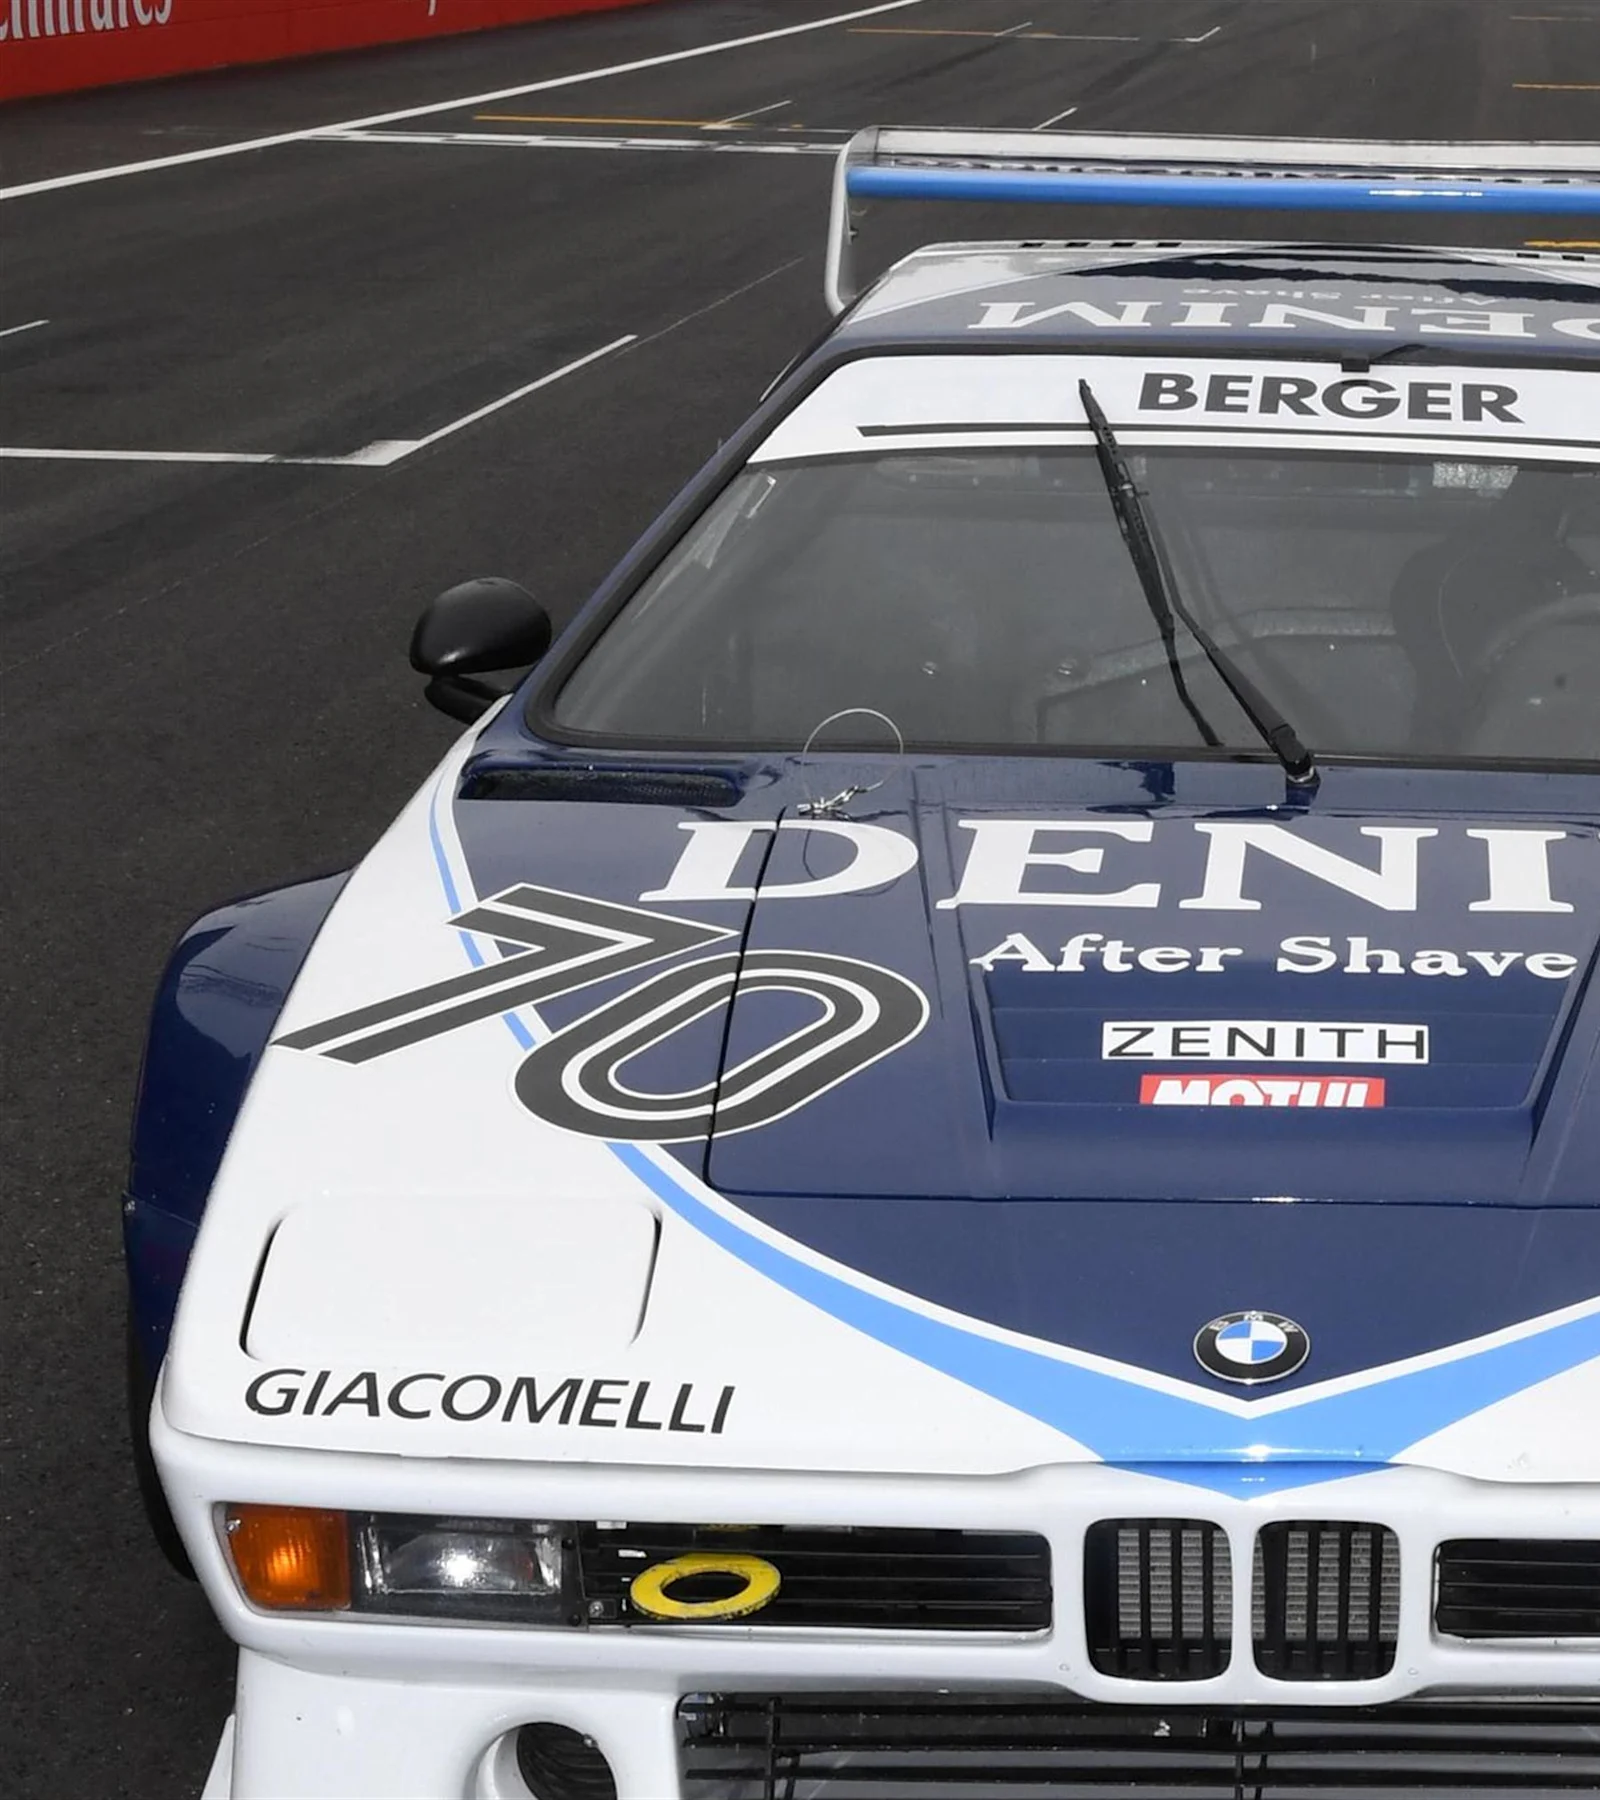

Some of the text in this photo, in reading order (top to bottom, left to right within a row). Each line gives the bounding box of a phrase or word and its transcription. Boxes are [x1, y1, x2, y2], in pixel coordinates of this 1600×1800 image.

[1138, 372, 1525, 424] BERGER
[969, 933, 1578, 979] After Shave
[271, 883, 931, 1144] 70
[1108, 1027, 1425, 1059] ZENITH
[1208, 1312, 1300, 1333] BMW
[245, 1367, 735, 1434] GIACOMELLI
